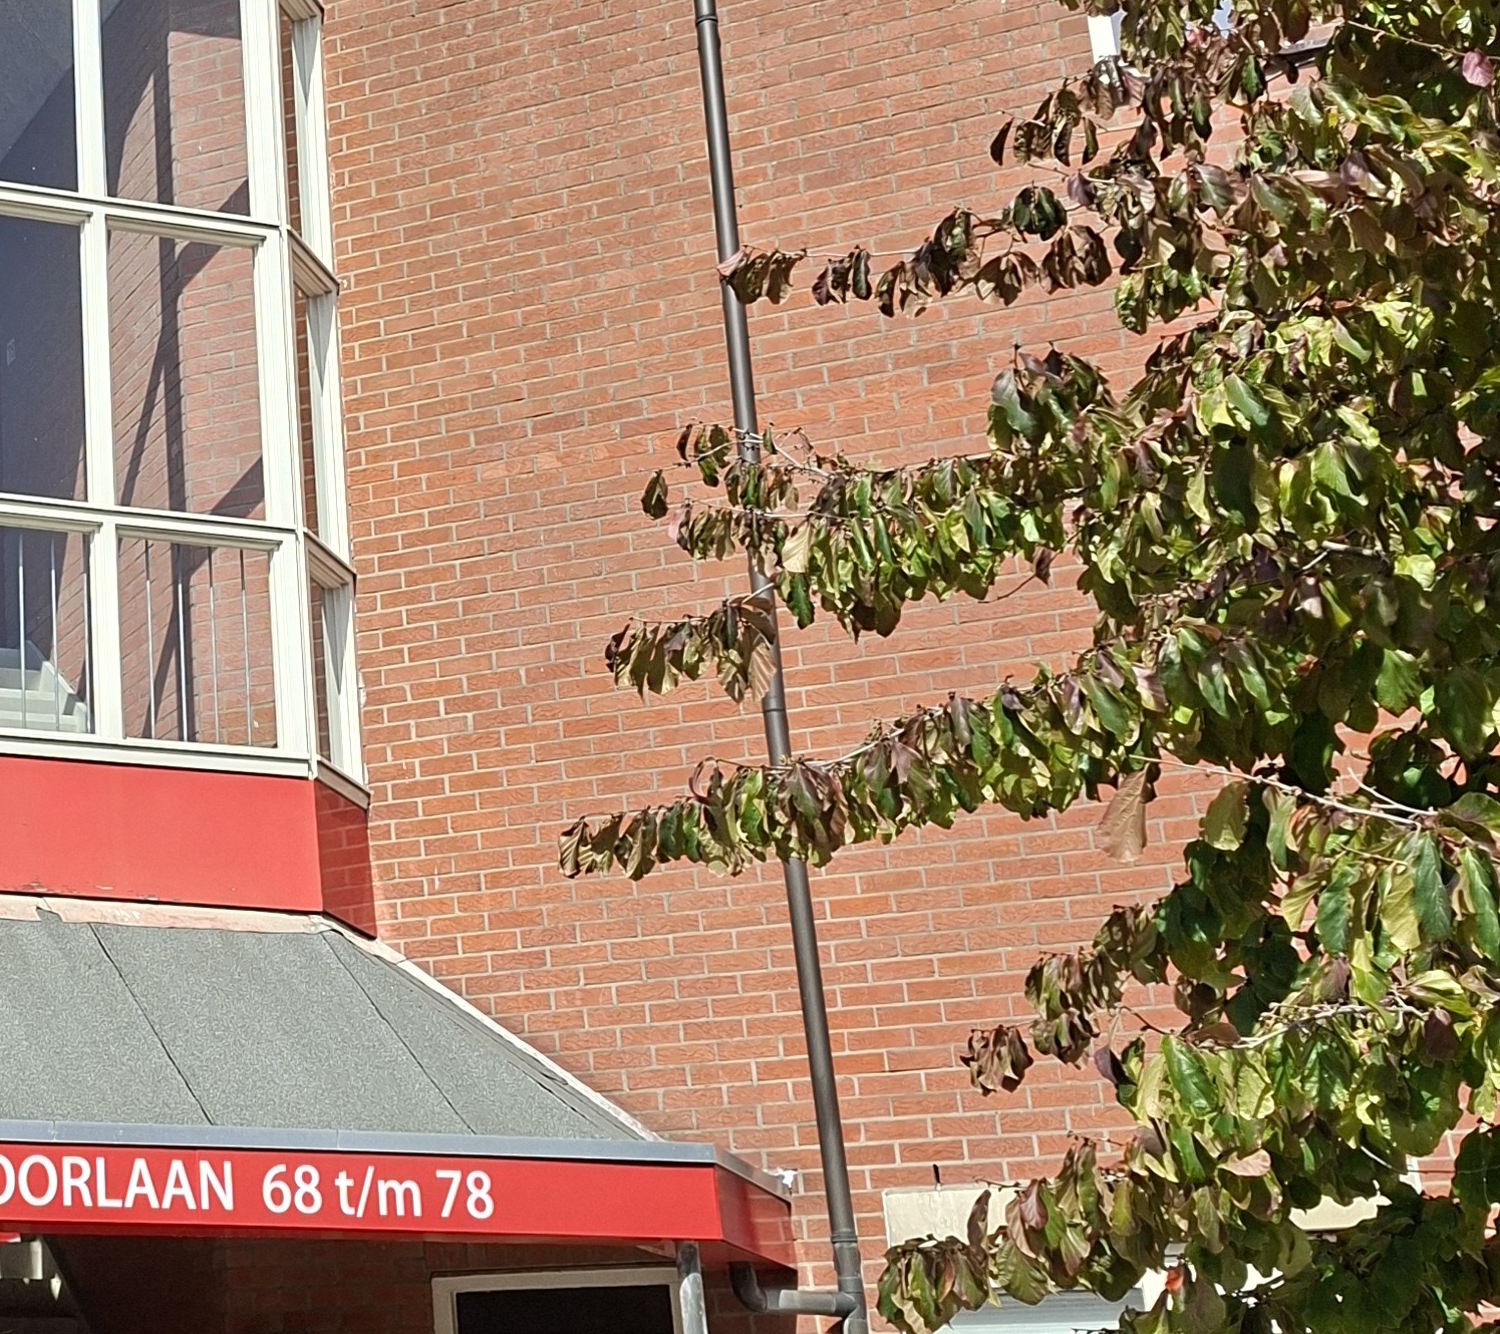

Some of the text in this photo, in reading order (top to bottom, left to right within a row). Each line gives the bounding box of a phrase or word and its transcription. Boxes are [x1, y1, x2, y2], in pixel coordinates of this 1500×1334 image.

[262, 1163, 323, 1215] 68
[334, 1165, 422, 1218] t/m
[435, 1169, 494, 1220] 78
